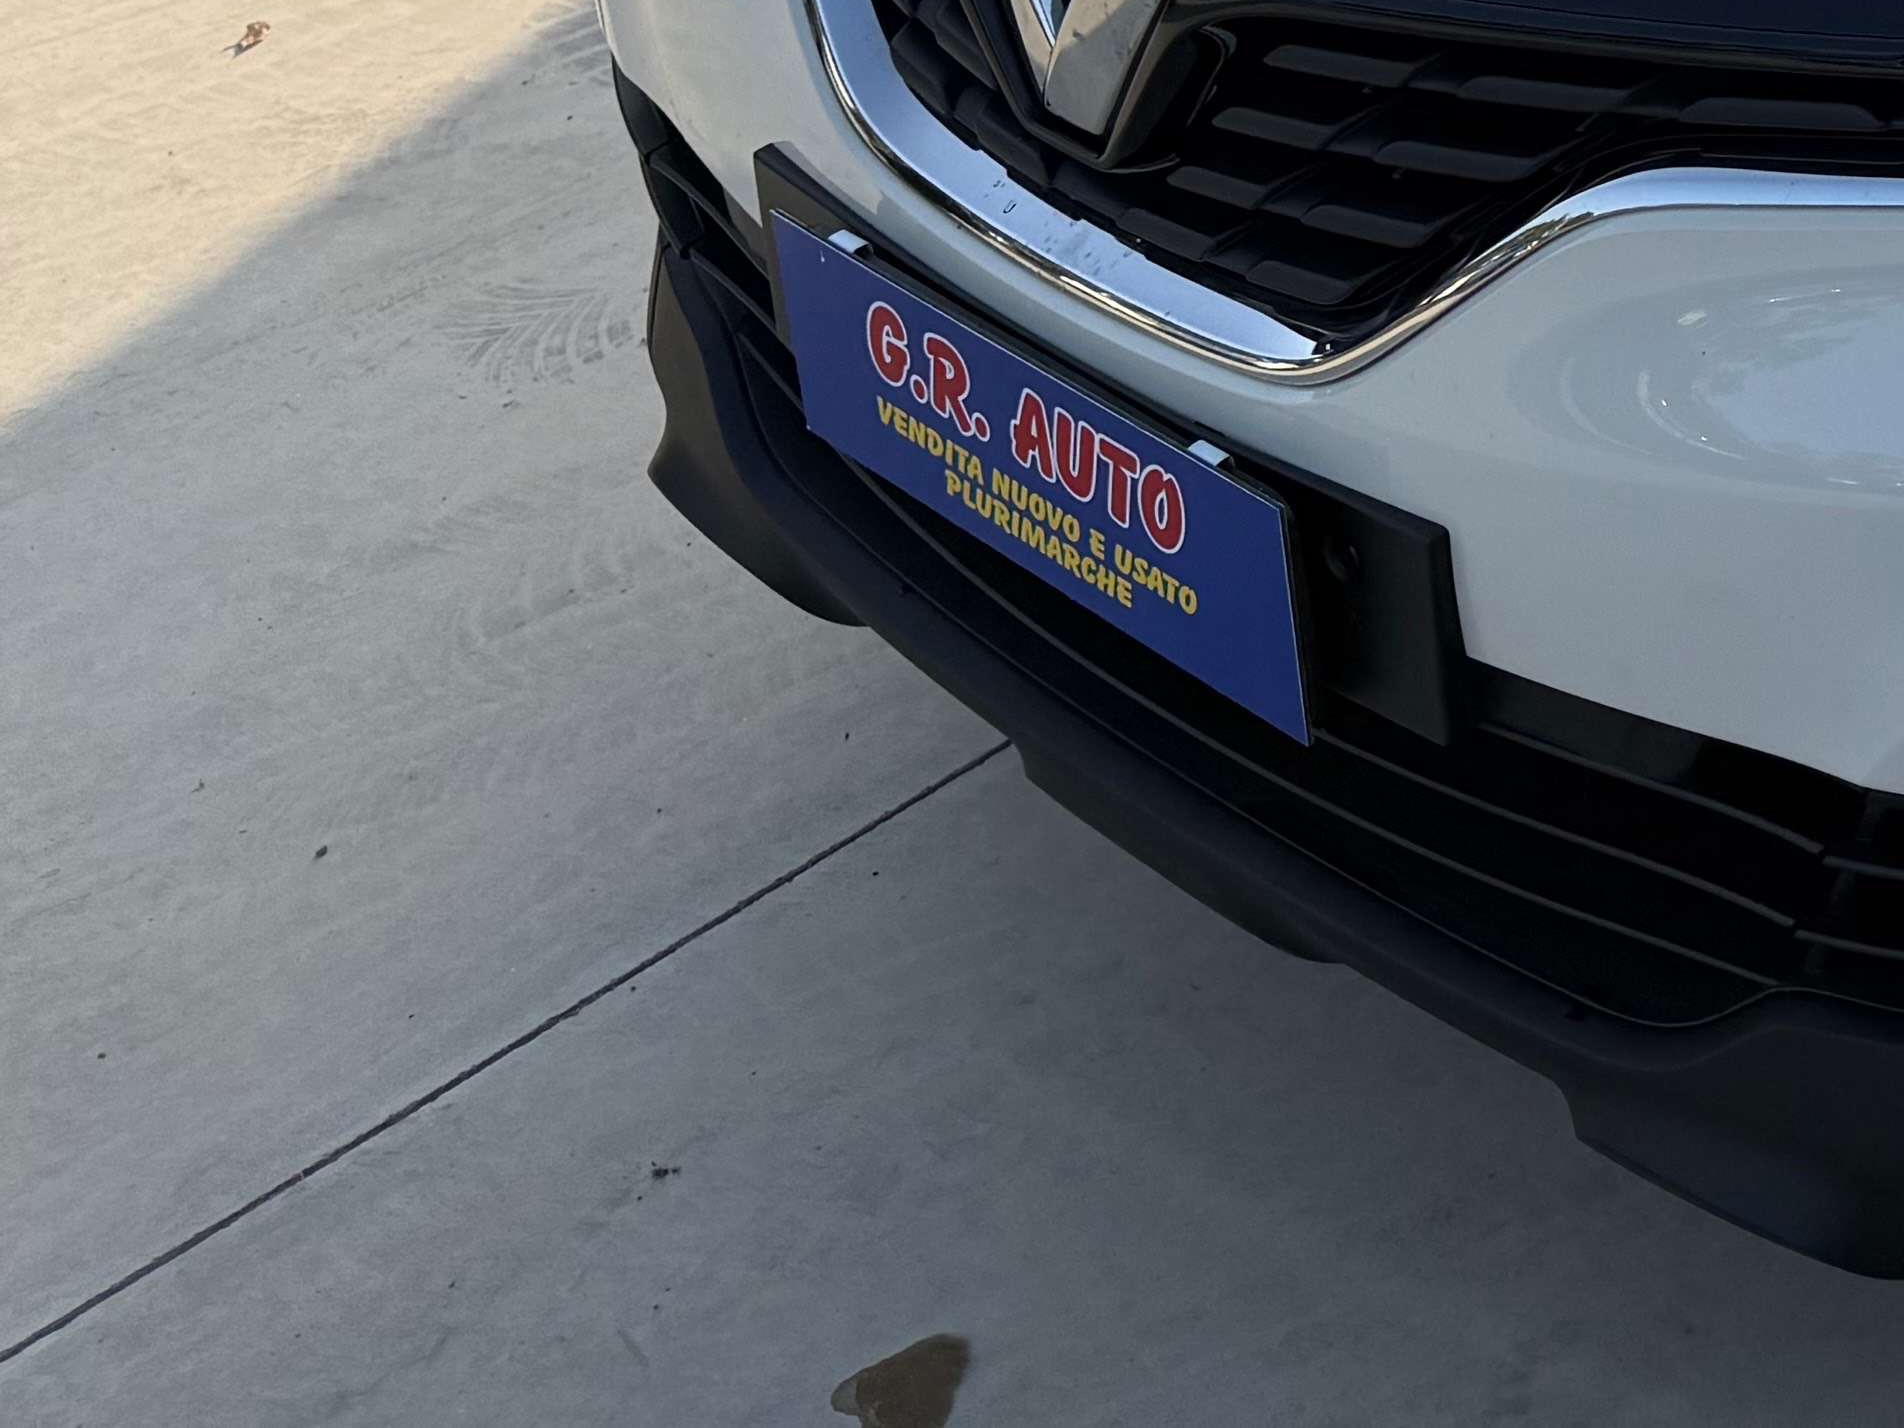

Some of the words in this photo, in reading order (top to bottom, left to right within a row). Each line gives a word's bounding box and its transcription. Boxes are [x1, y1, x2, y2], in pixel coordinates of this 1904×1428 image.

[866, 300, 992, 443] G.R.
[1011, 387, 1187, 555] AUTO
[875, 395, 985, 484] VENDITA
[991, 467, 1082, 544] NUOVO
[1089, 527, 1106, 562] E
[1114, 547, 1198, 616] USATO
[944, 469, 1134, 610] PLURIMARCHE
